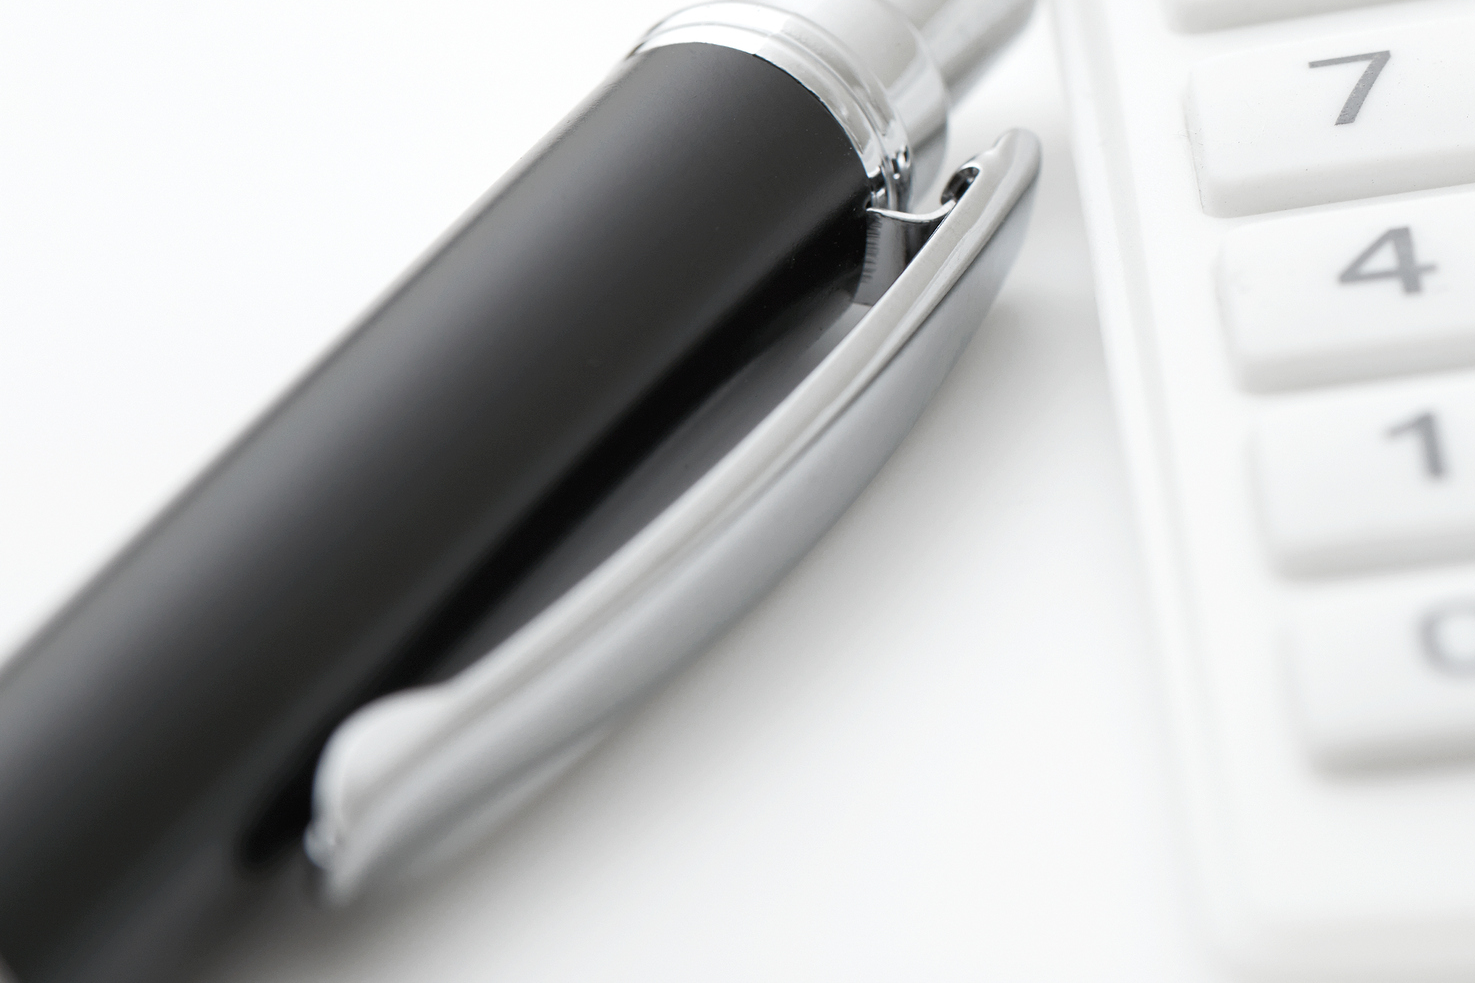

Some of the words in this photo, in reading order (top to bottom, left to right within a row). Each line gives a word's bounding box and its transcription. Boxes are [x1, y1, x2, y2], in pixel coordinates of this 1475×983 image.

[1307, 47, 1393, 129] 7
[1335, 224, 1438, 298] 4
[1384, 408, 1453, 484] 1
